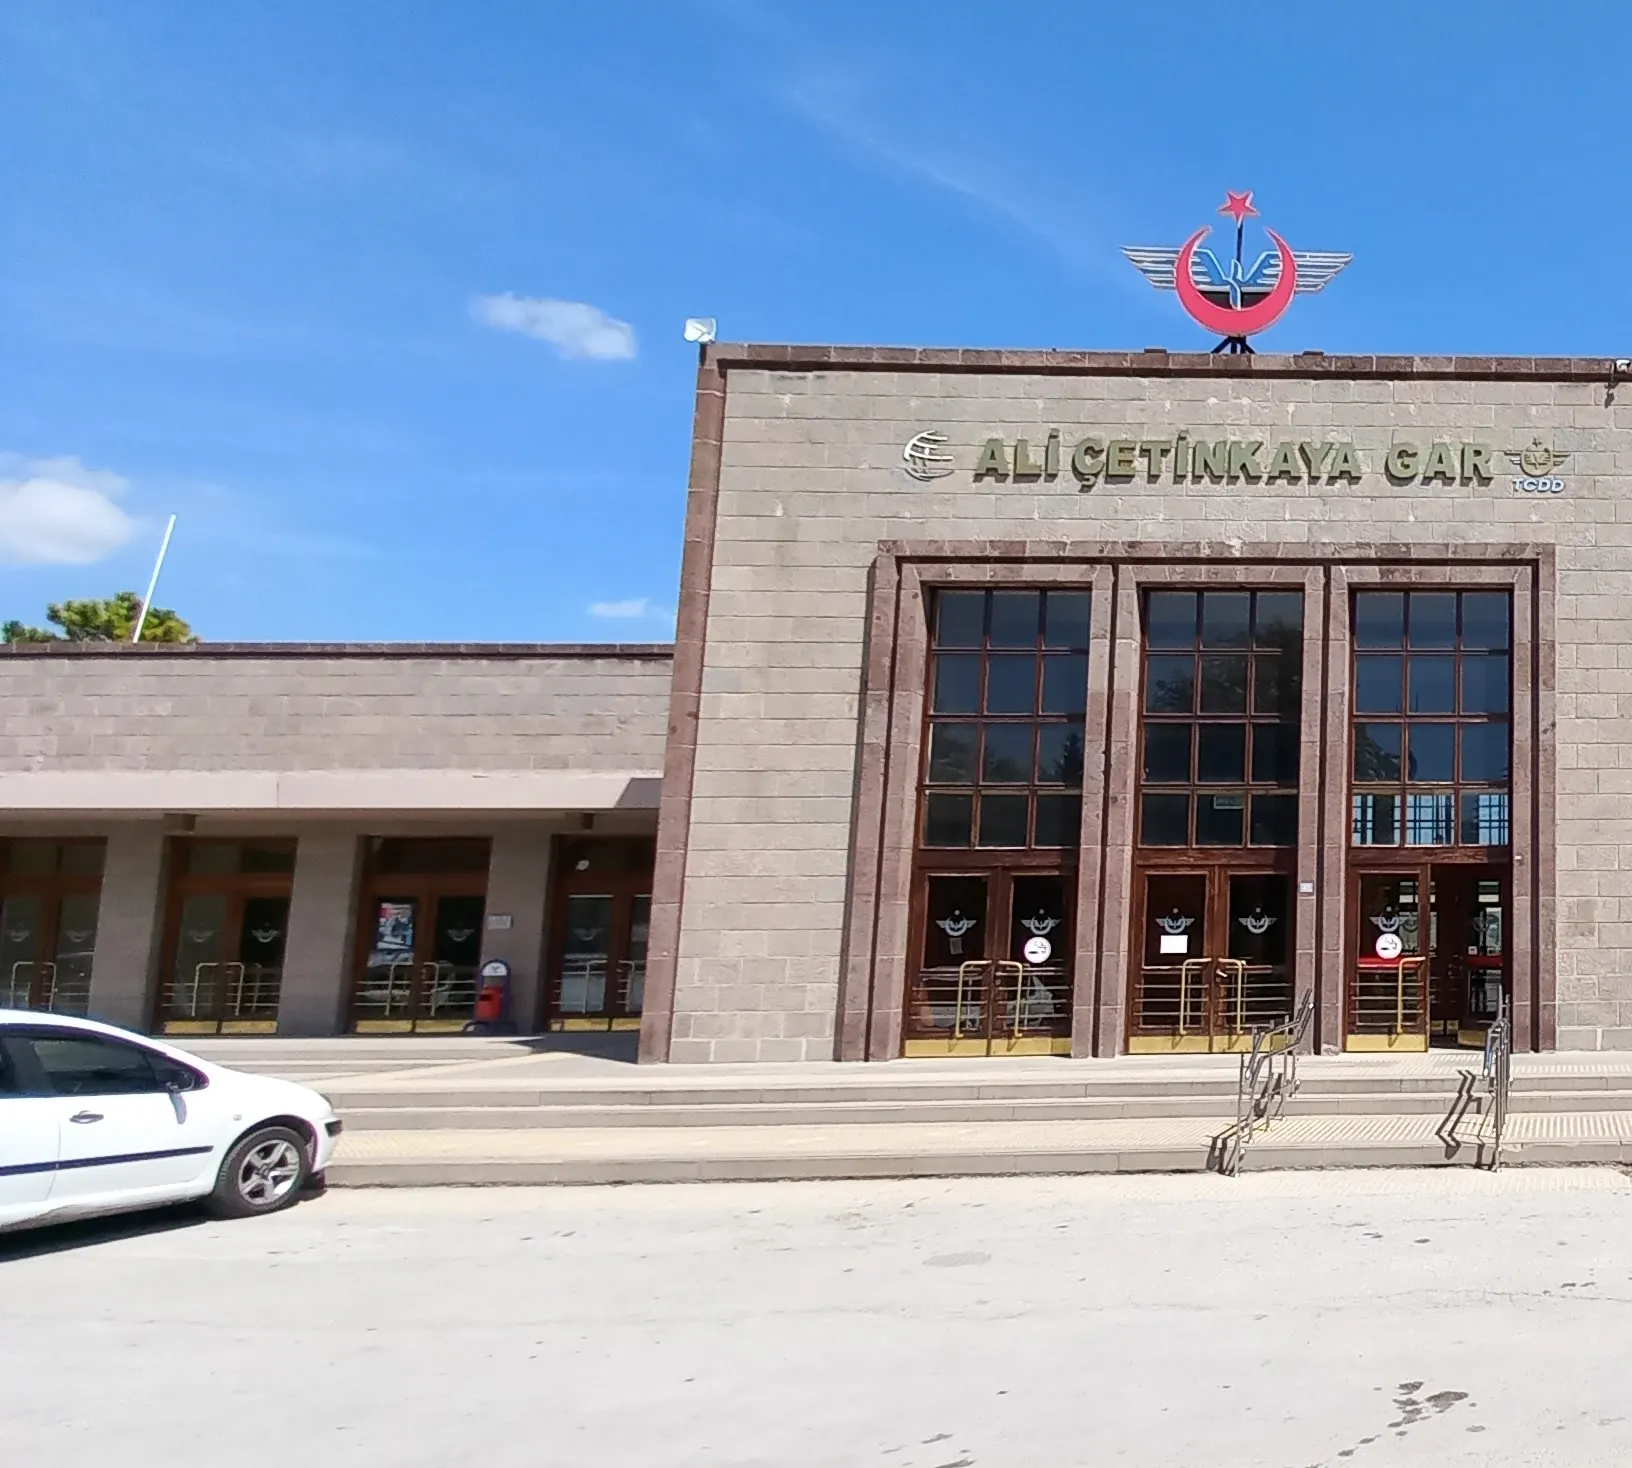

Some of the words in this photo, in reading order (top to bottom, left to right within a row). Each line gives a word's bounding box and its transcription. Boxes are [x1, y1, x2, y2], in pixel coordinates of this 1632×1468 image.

[975, 428, 1061, 482] ALİ
[1072, 430, 1362, 492] ÇETİNKAYA
[1385, 441, 1494, 486] GAR
[1513, 477, 1565, 493] TCDD
